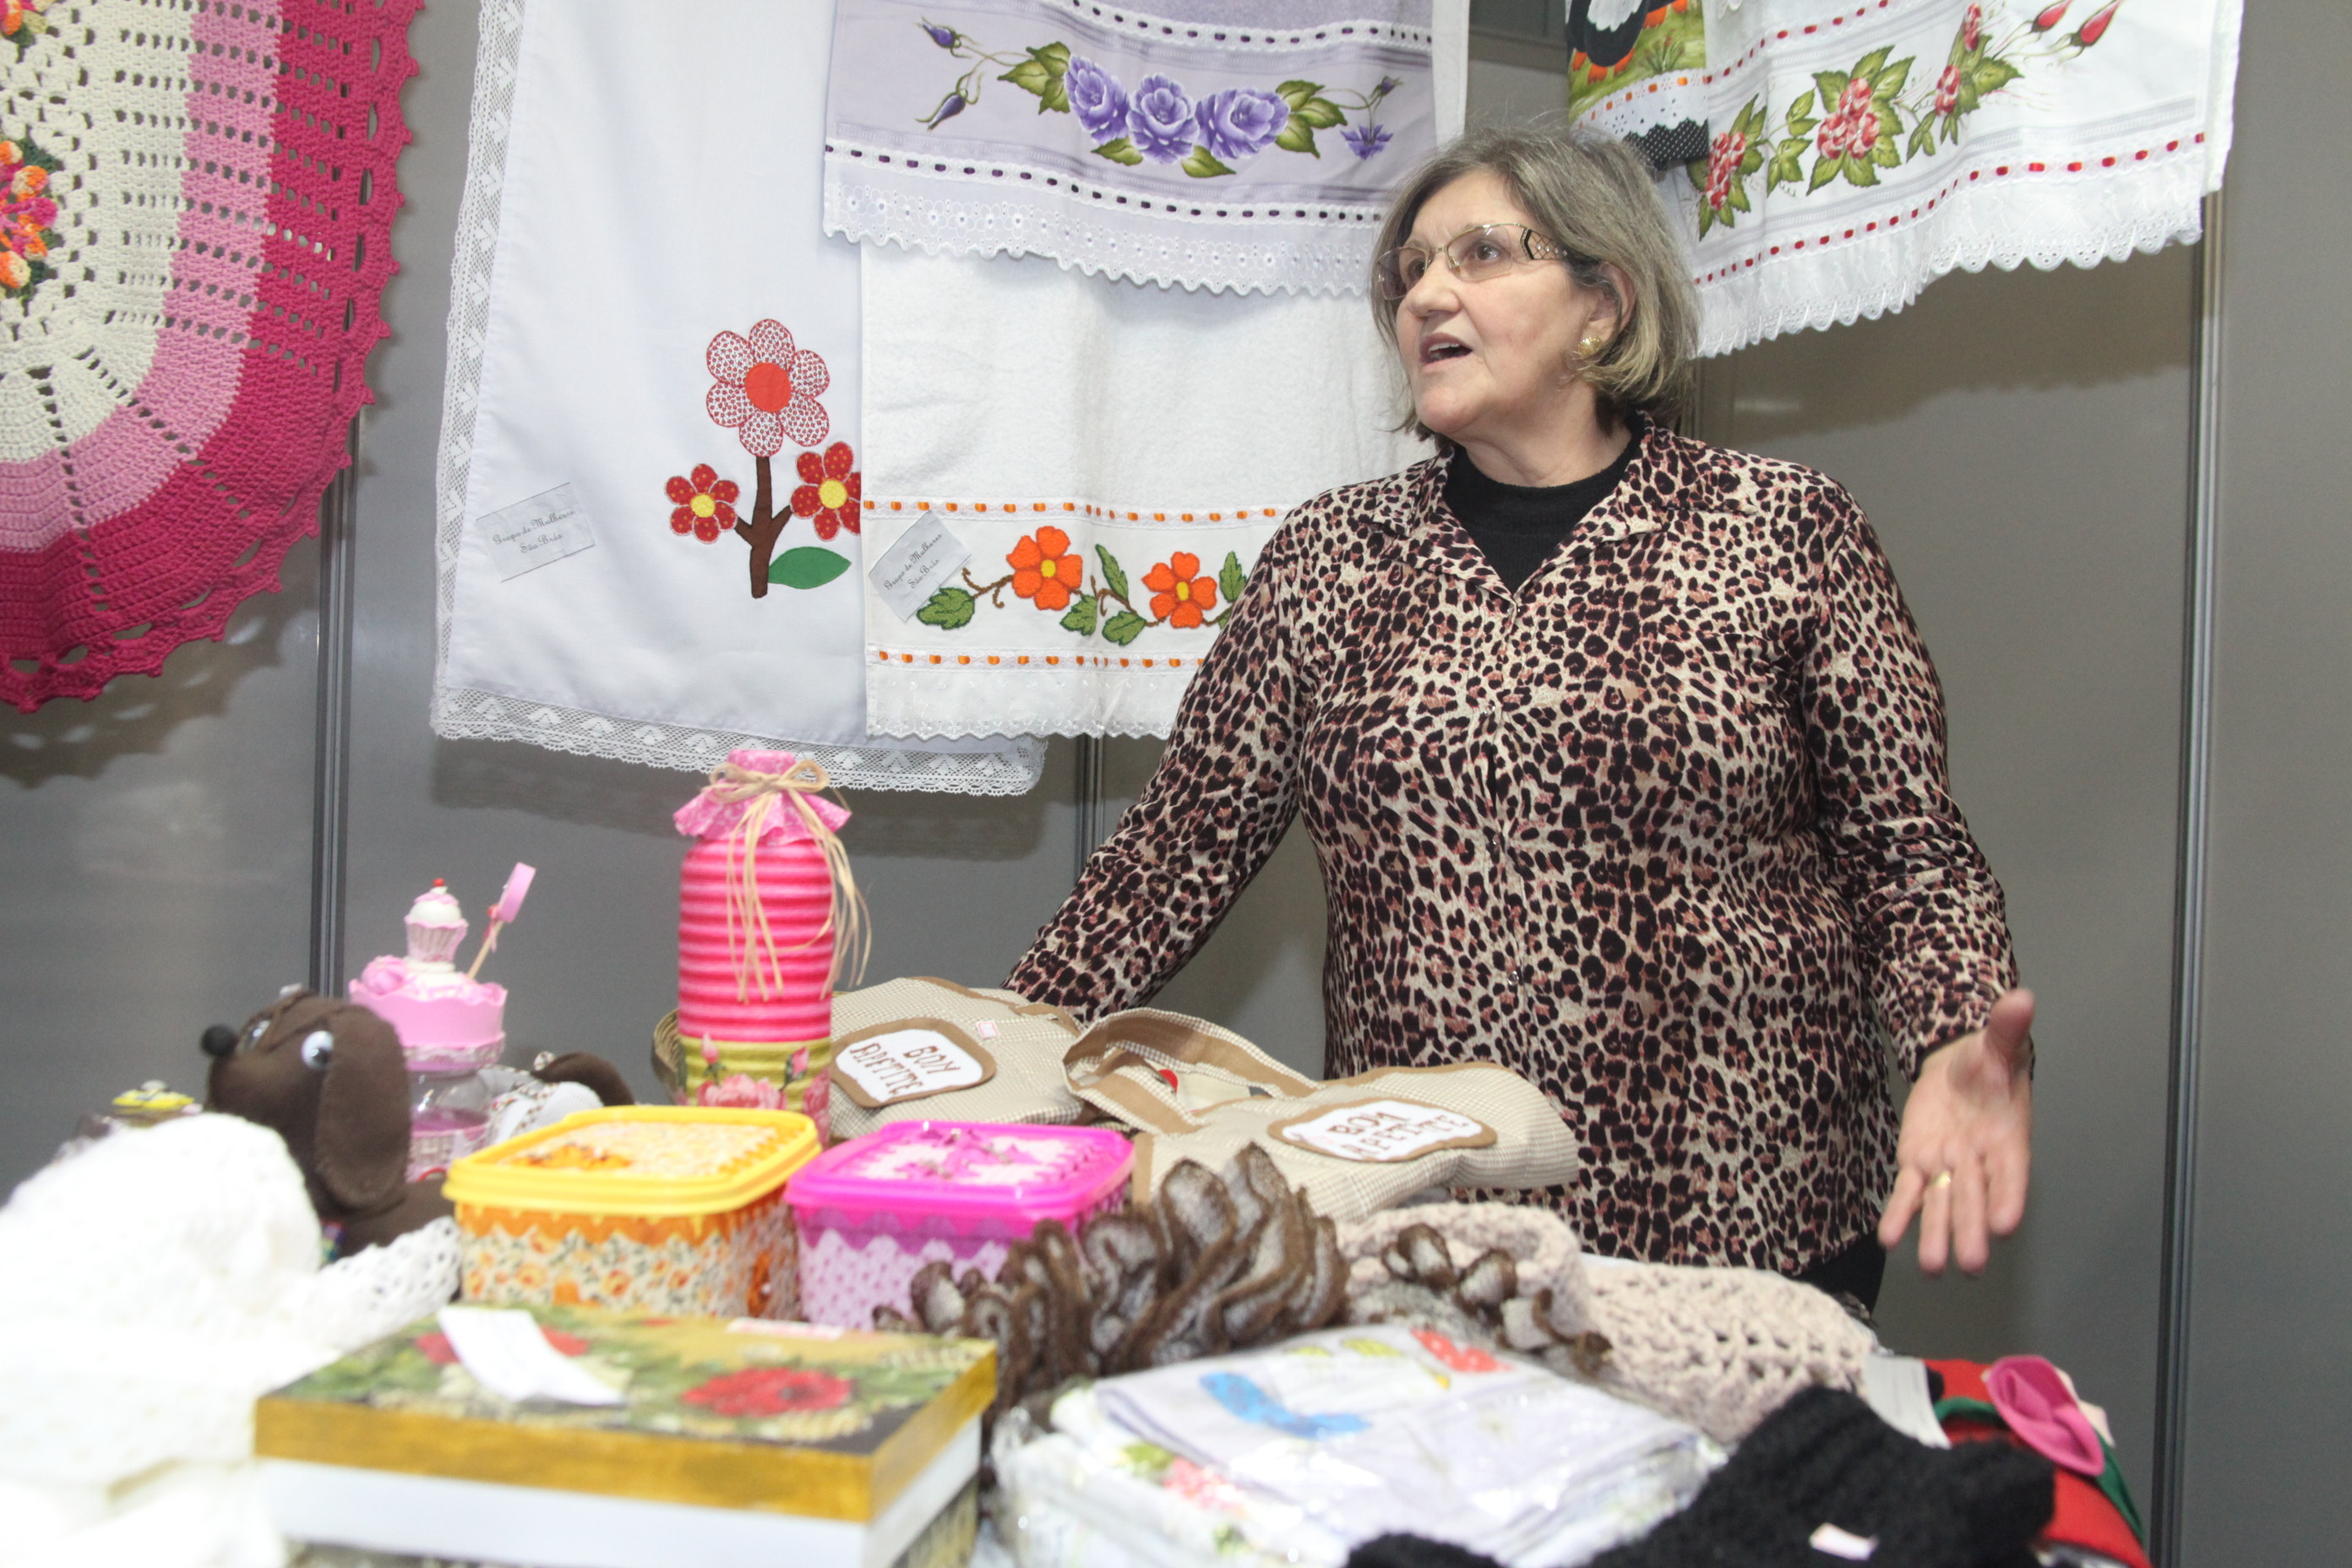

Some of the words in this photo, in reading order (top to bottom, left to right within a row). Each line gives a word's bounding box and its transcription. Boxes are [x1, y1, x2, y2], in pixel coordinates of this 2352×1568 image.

[493, 532, 520, 545] Grupo
[531, 510, 574, 531] Mulheres
[520, 543, 537, 553] São
[884, 571, 905, 591] Grupo
[909, 533, 942, 564] Mulheres
[907, 576, 923, 589] São
[919, 558, 940, 577] Brás
